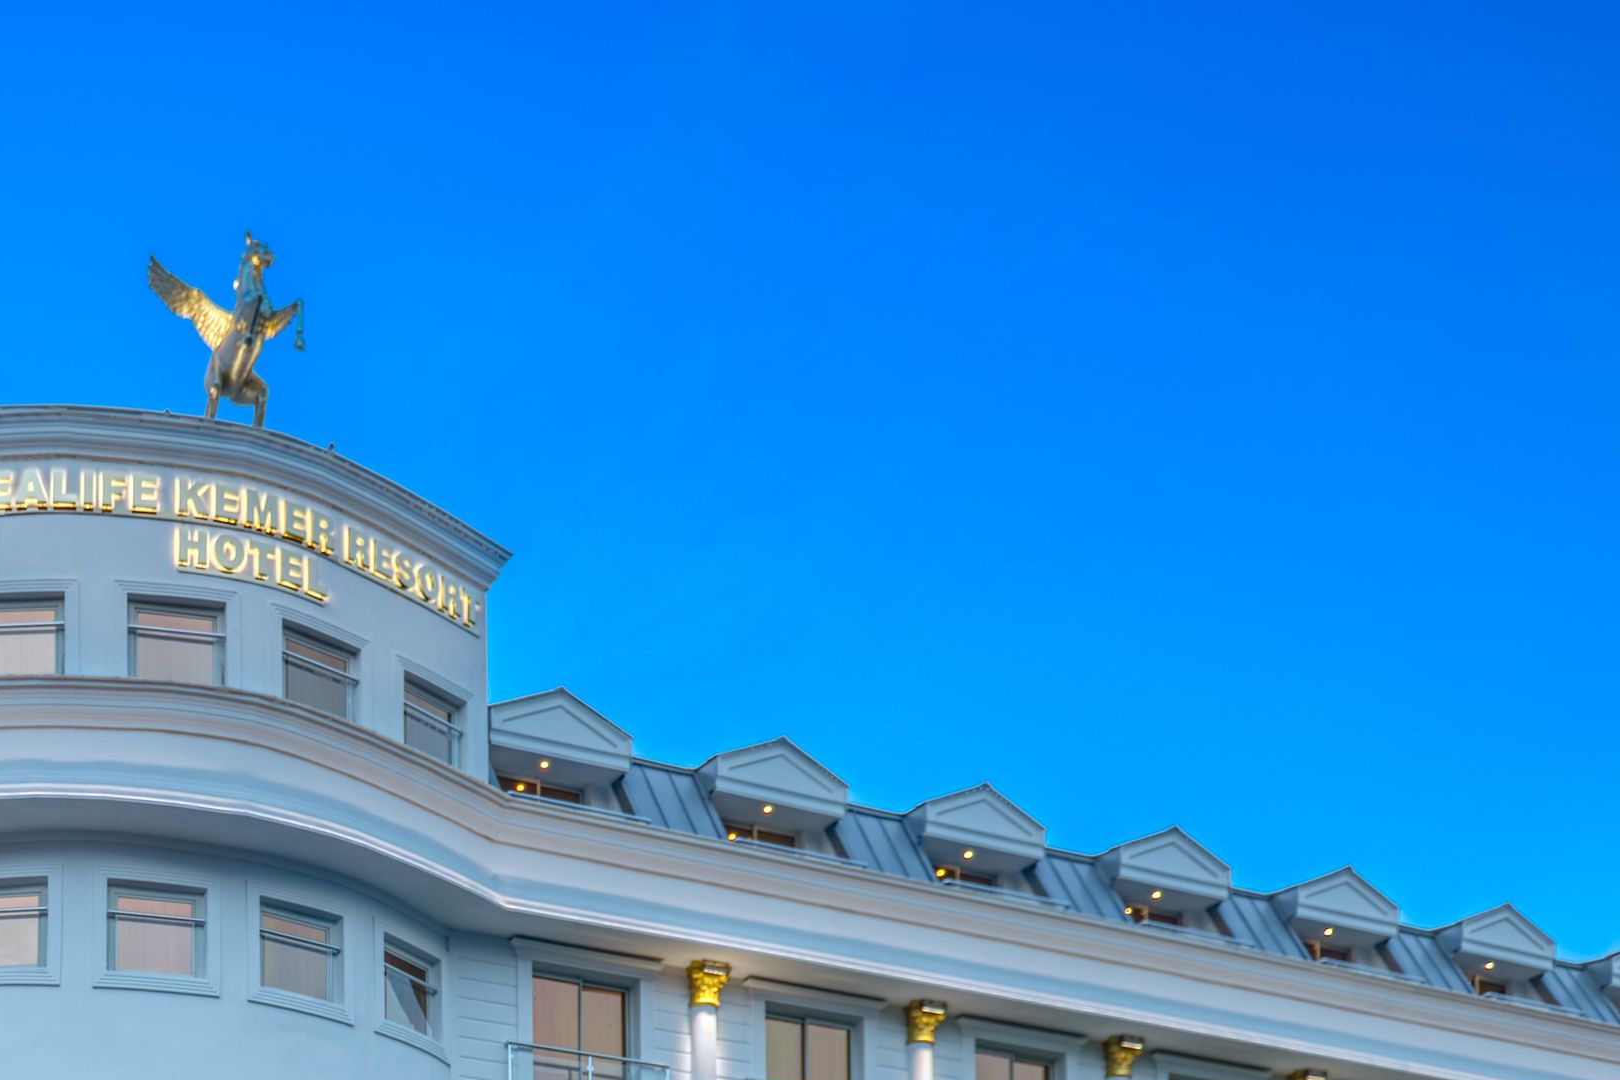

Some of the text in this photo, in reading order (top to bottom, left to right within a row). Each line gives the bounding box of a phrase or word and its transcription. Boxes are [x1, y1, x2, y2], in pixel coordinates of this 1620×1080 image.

[174, 526, 329, 602] HOTEL
[175, 476, 336, 556] KEMER
[343, 523, 476, 628] RESORT
